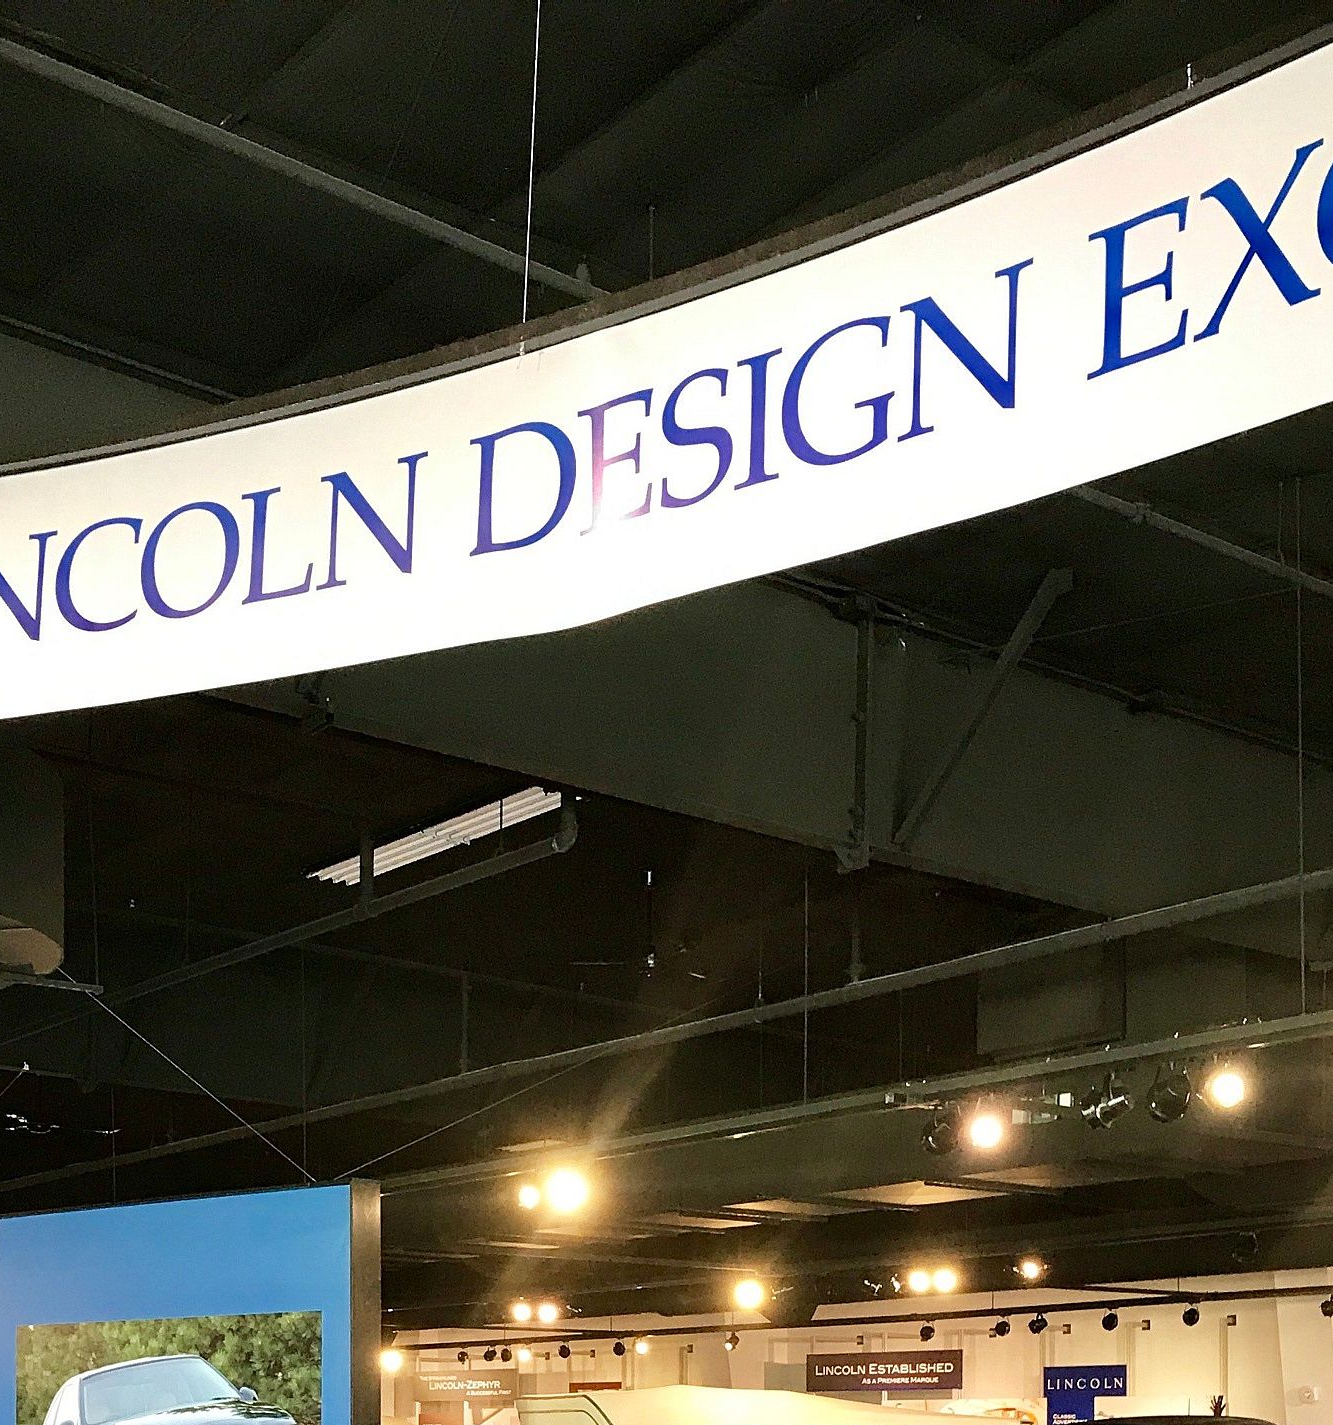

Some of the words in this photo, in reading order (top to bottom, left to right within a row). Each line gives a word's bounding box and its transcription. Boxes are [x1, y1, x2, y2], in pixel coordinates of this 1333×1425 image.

[469, 257, 1034, 557] DESIGN
[815, 1364, 866, 1376] LINCOLN
[868, 1362, 954, 1375] ESTABLISHED
[429, 1379, 501, 1391] LINCOLN-ZEPHYR
[1048, 1377, 1123, 1390] LINCOLN
